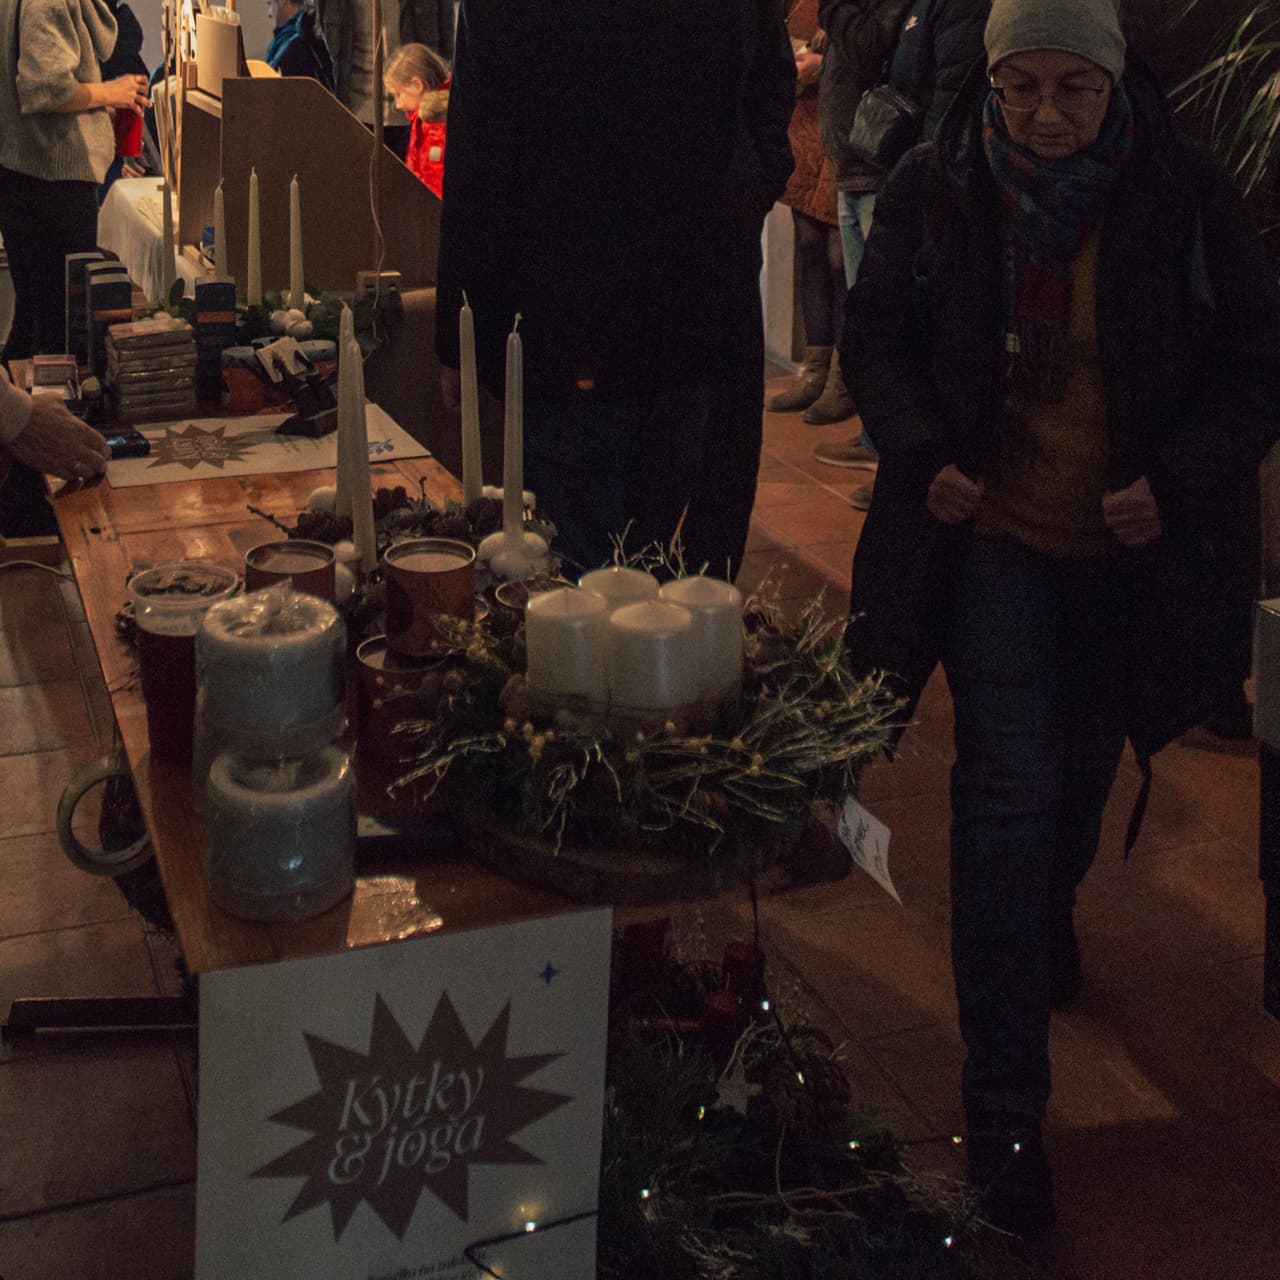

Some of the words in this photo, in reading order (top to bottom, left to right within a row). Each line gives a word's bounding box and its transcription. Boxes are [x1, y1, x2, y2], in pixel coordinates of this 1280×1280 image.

[338, 1060, 485, 1136] Kytky
[328, 1133, 371, 1184] &
[376, 1115, 486, 1186] jóga
